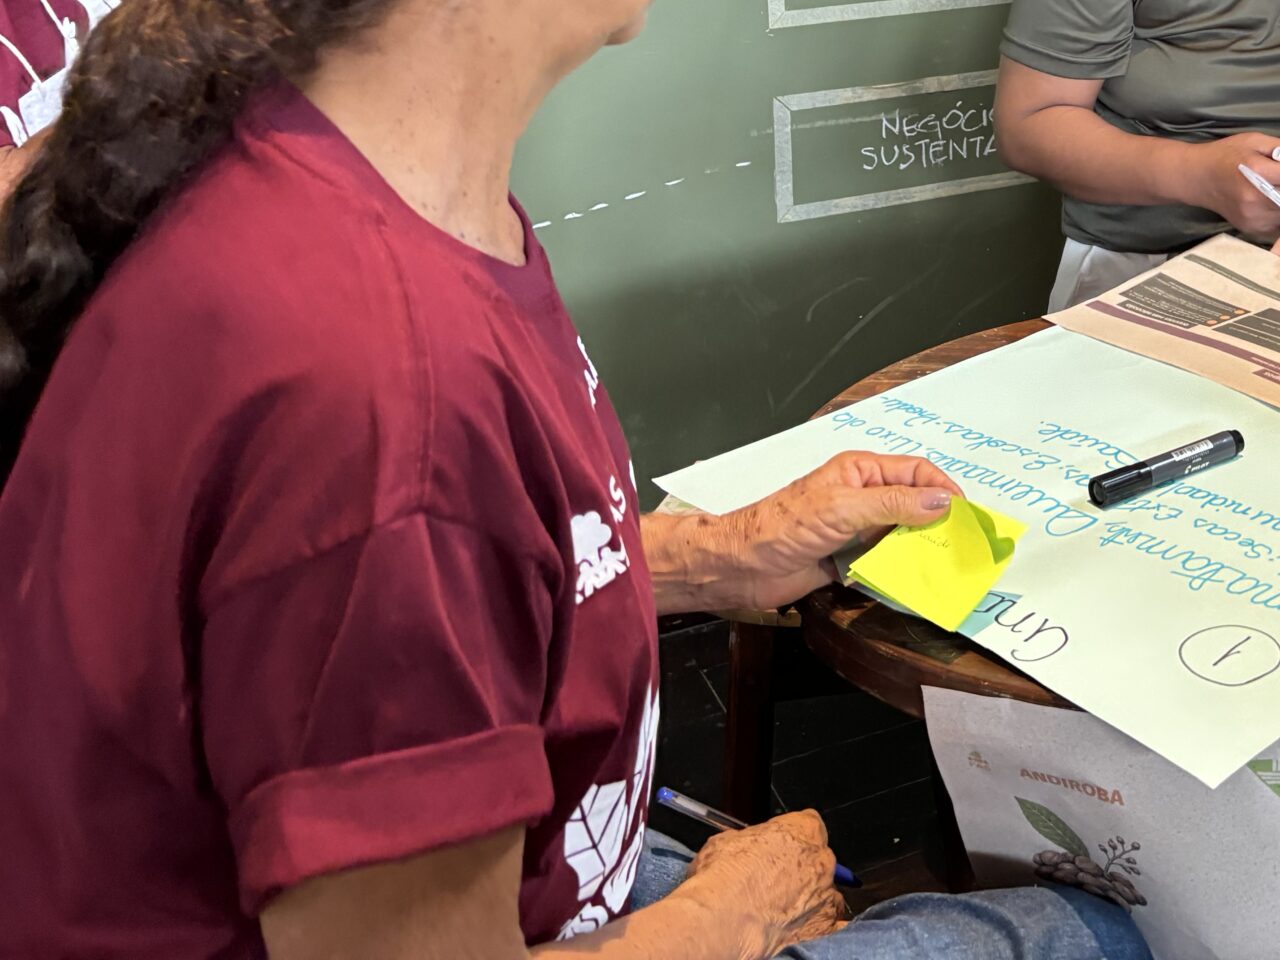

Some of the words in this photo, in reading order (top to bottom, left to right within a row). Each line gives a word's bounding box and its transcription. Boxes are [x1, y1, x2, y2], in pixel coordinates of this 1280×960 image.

[861, 134, 997, 170] SUSTENTA
[1213, 636, 1252, 667] 1
[1019, 767, 1125, 807] ANDIROBA
